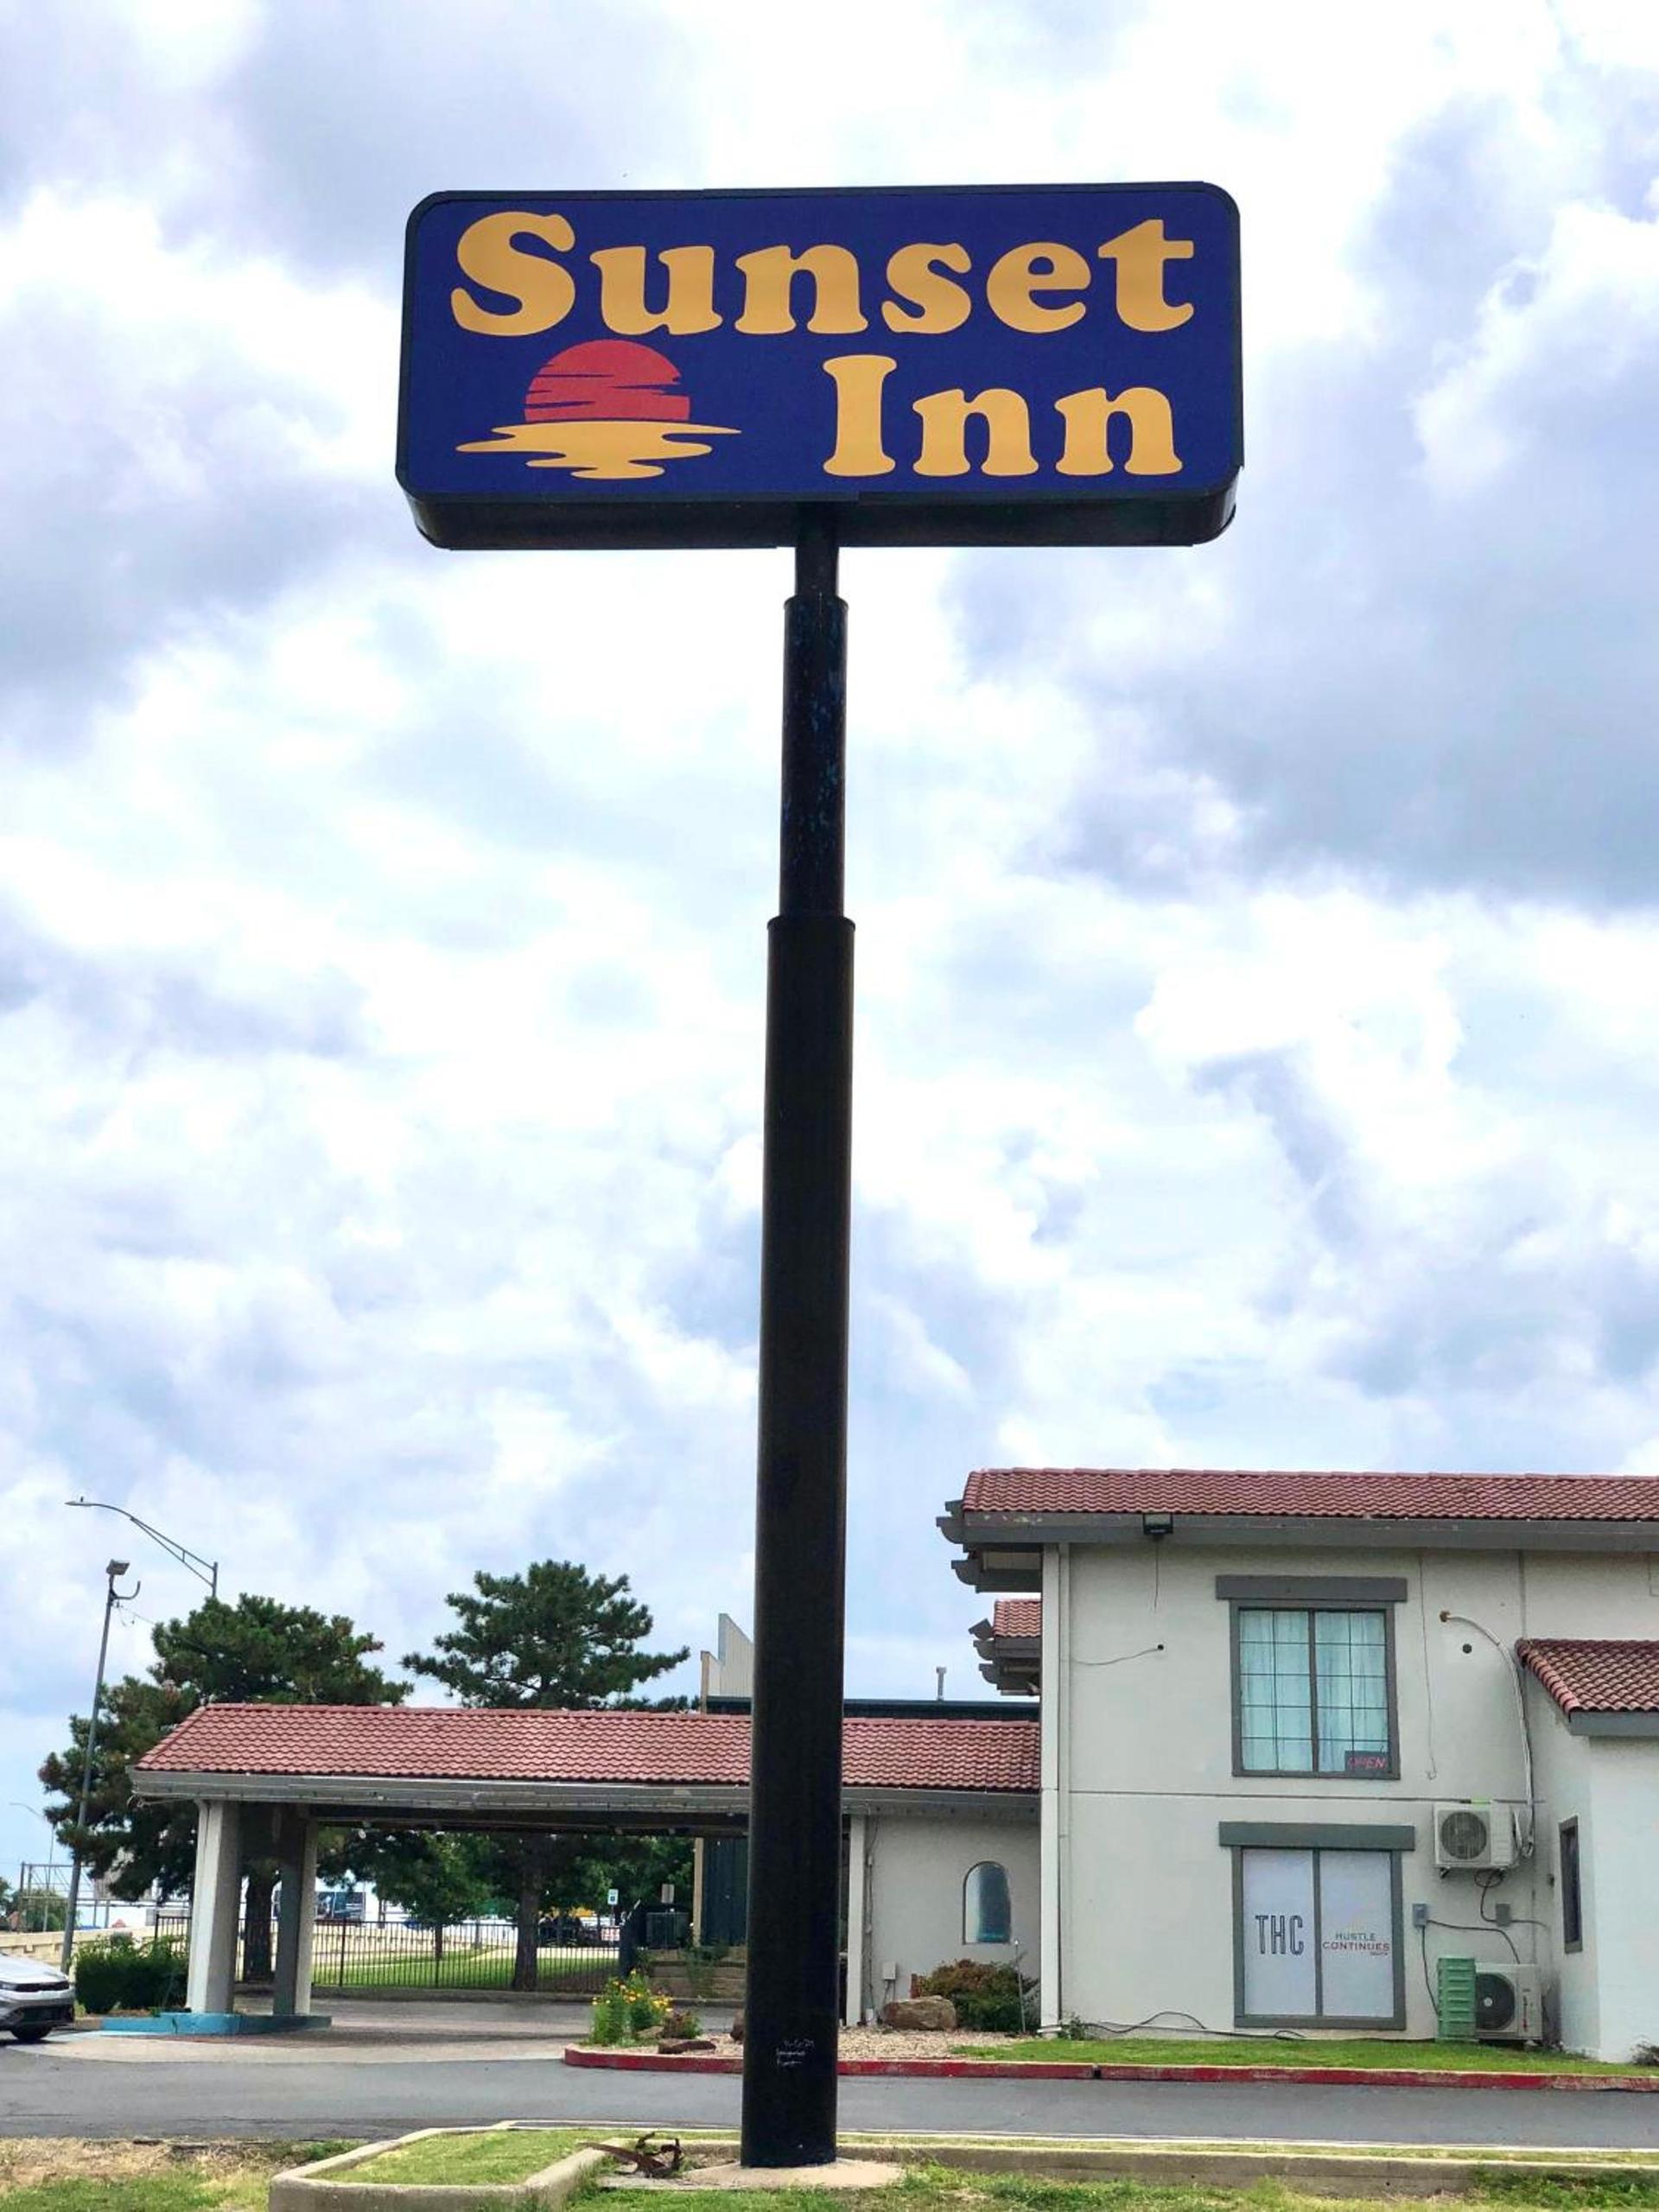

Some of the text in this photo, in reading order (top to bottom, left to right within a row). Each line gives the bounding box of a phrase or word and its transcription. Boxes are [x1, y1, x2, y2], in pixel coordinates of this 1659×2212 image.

[451, 211, 1194, 336] Sunset
[823, 354, 1182, 477] Inn
[1255, 1915, 1305, 1955] THC
[1322, 1942, 1390, 1952] CONTINUES
[1335, 1932, 1376, 1942] HUSTLE
